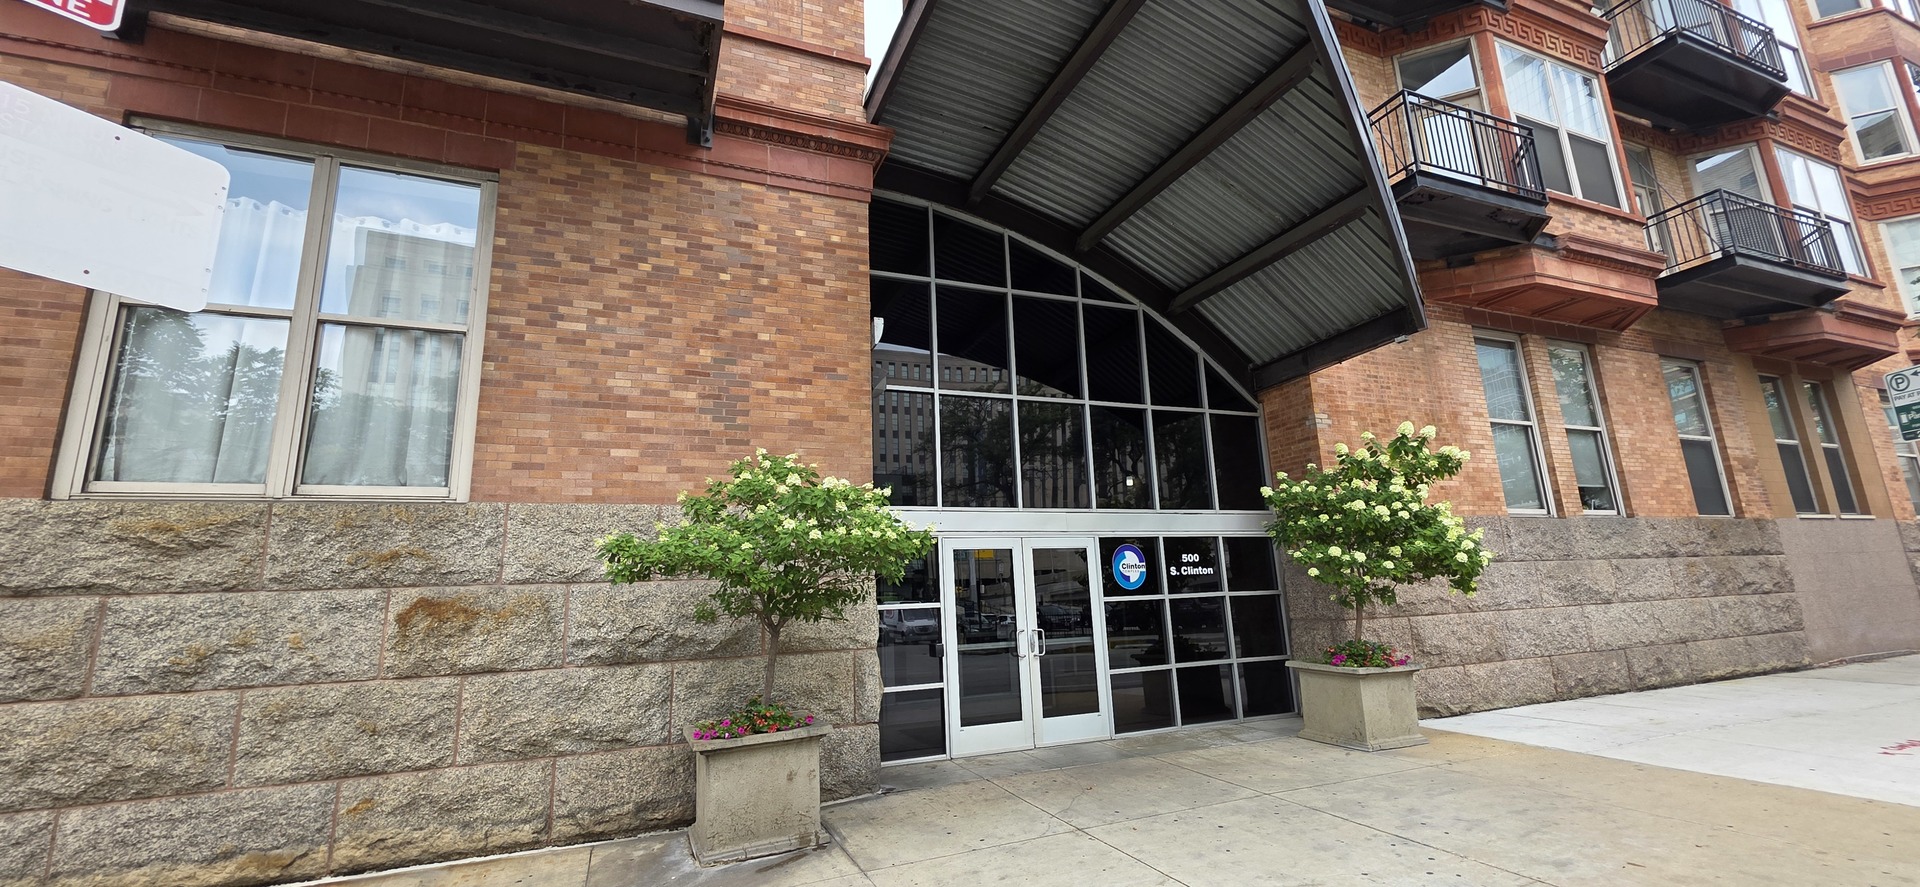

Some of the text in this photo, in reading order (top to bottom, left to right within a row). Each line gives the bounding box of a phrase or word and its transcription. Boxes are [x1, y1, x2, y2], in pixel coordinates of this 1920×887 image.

[1894, 376, 1905, 389] P
[1894, 394, 1906, 402] PAY
[1181, 553, 1200, 562] 500
[1170, 566, 1214, 575] S. Clinton
